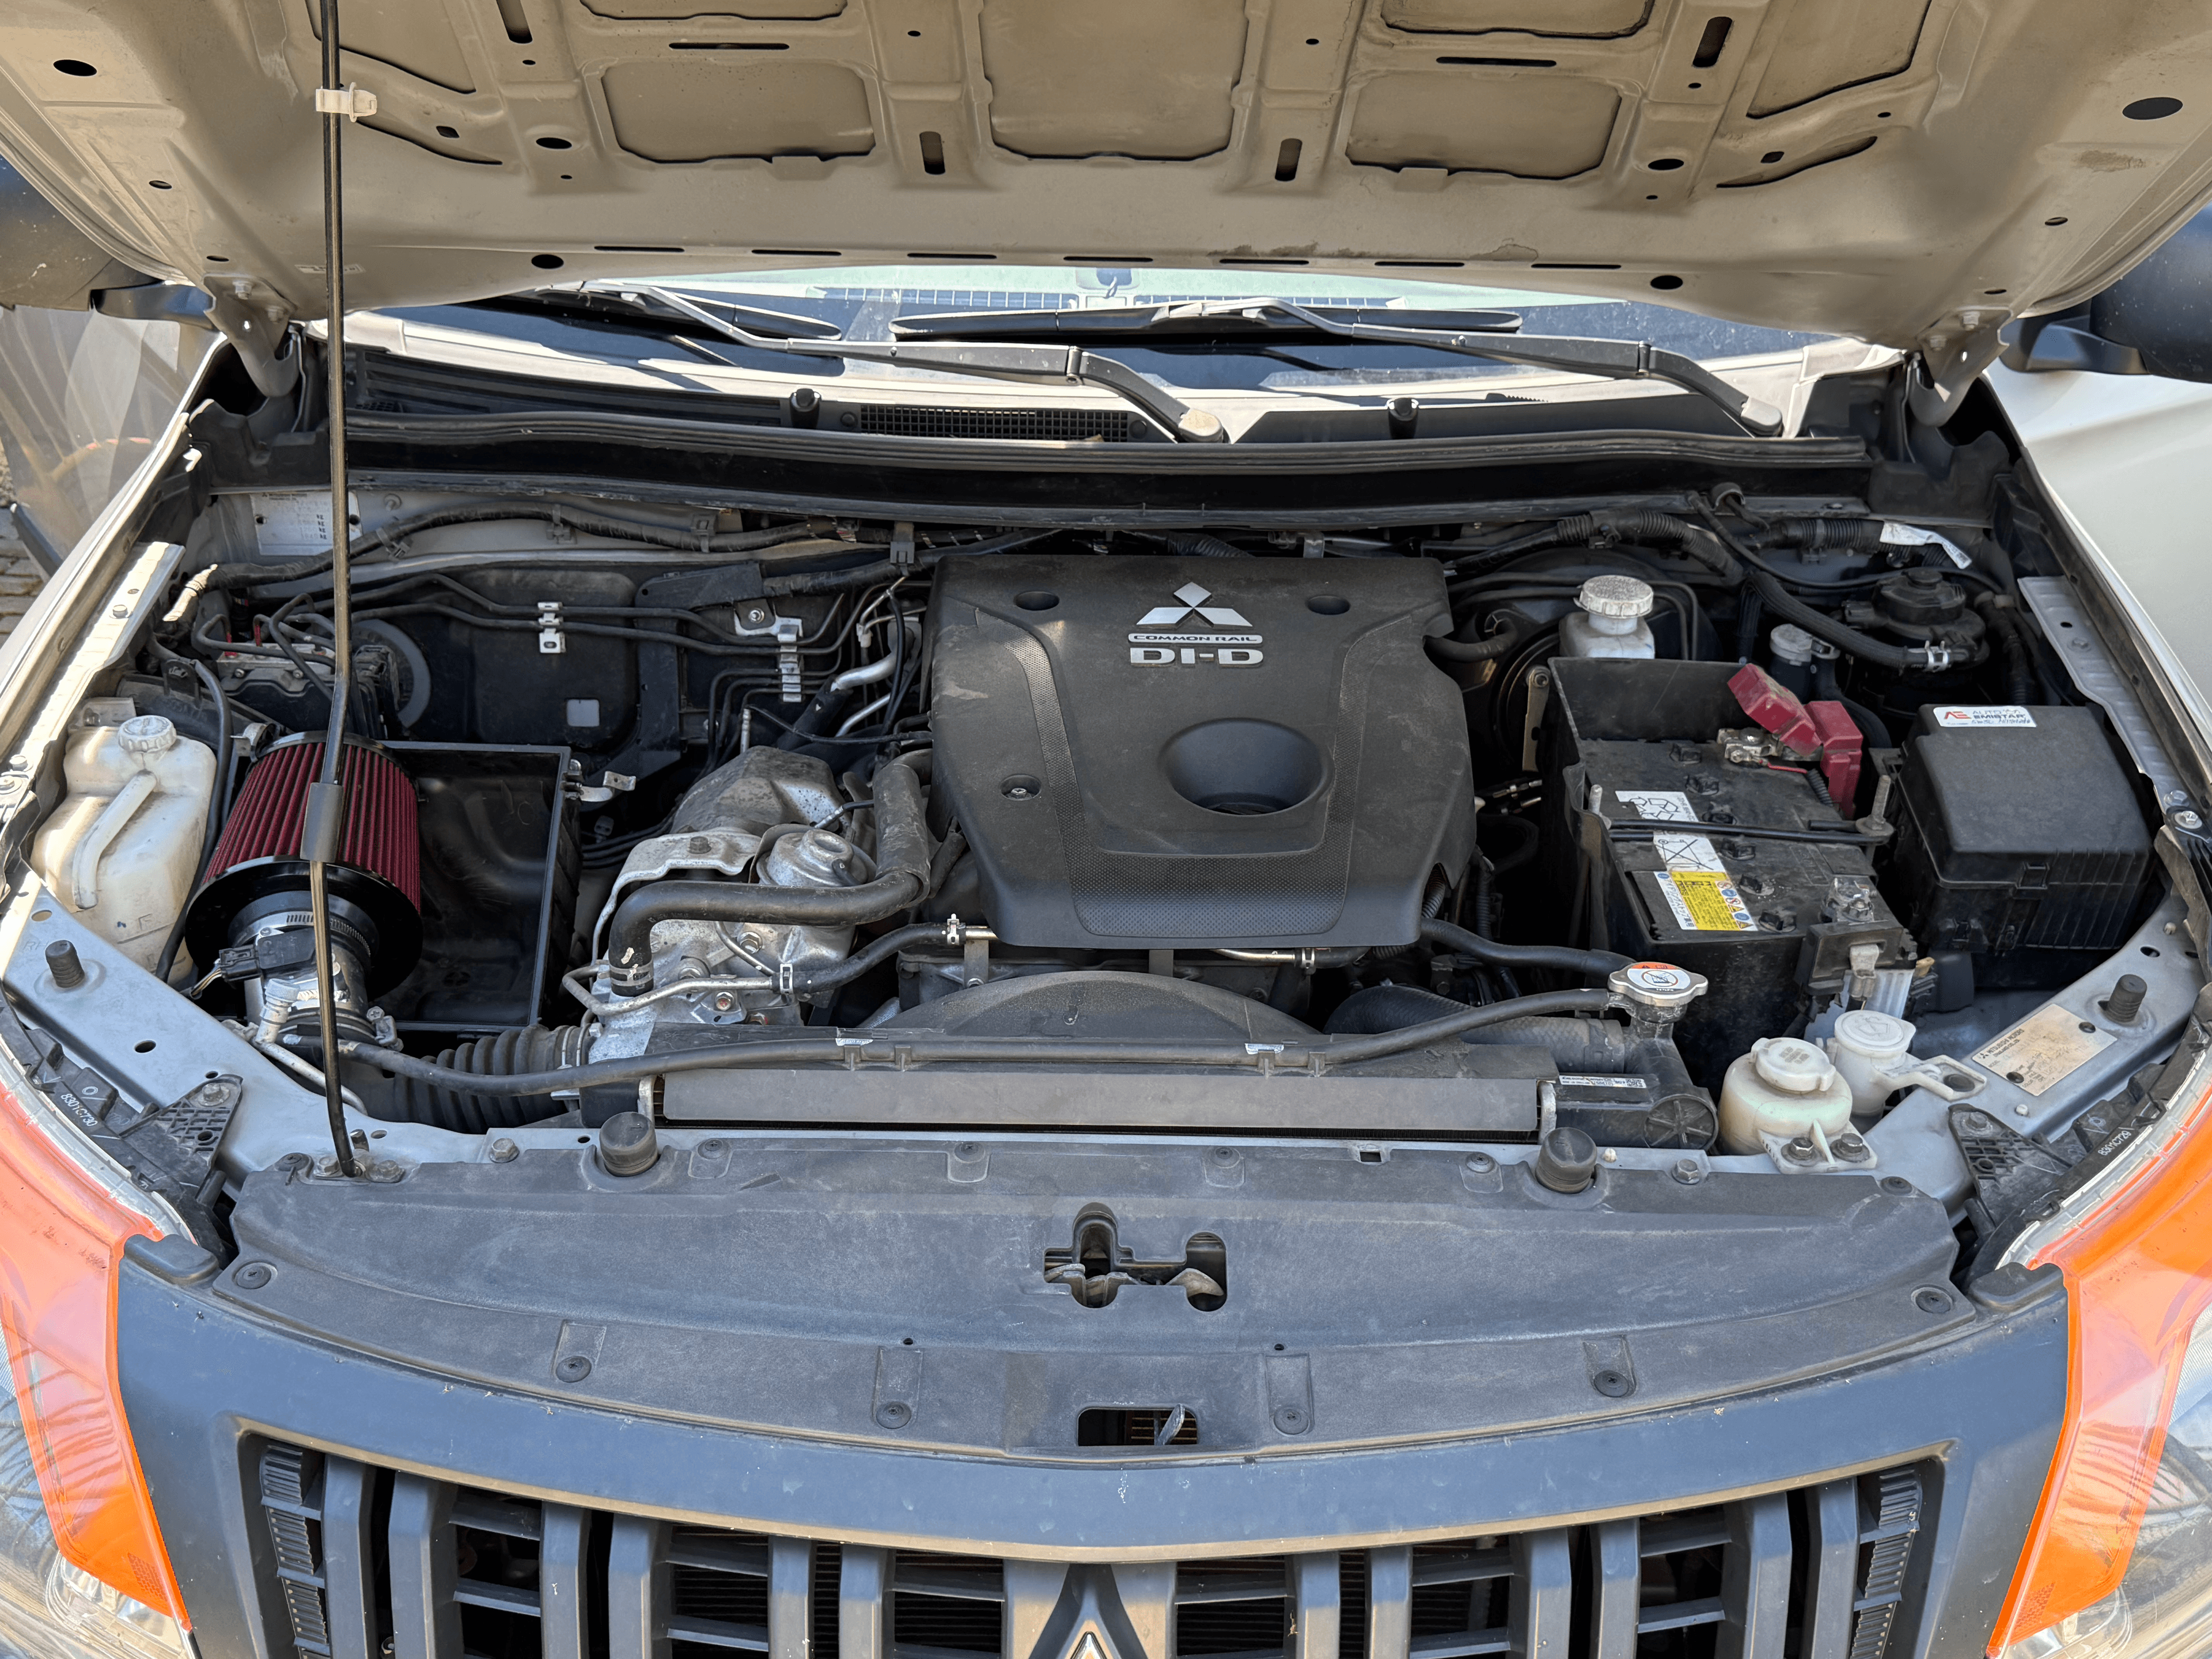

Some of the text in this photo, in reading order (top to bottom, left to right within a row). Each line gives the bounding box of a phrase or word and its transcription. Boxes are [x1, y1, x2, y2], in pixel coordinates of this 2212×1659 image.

[1130, 647, 1264, 665] DI-D
[1987, 1039, 2009, 1054] MITSUBISHI
[60, 1093, 98, 1127] 8301C730
[2097, 1130, 2132, 1156] 8301C729
